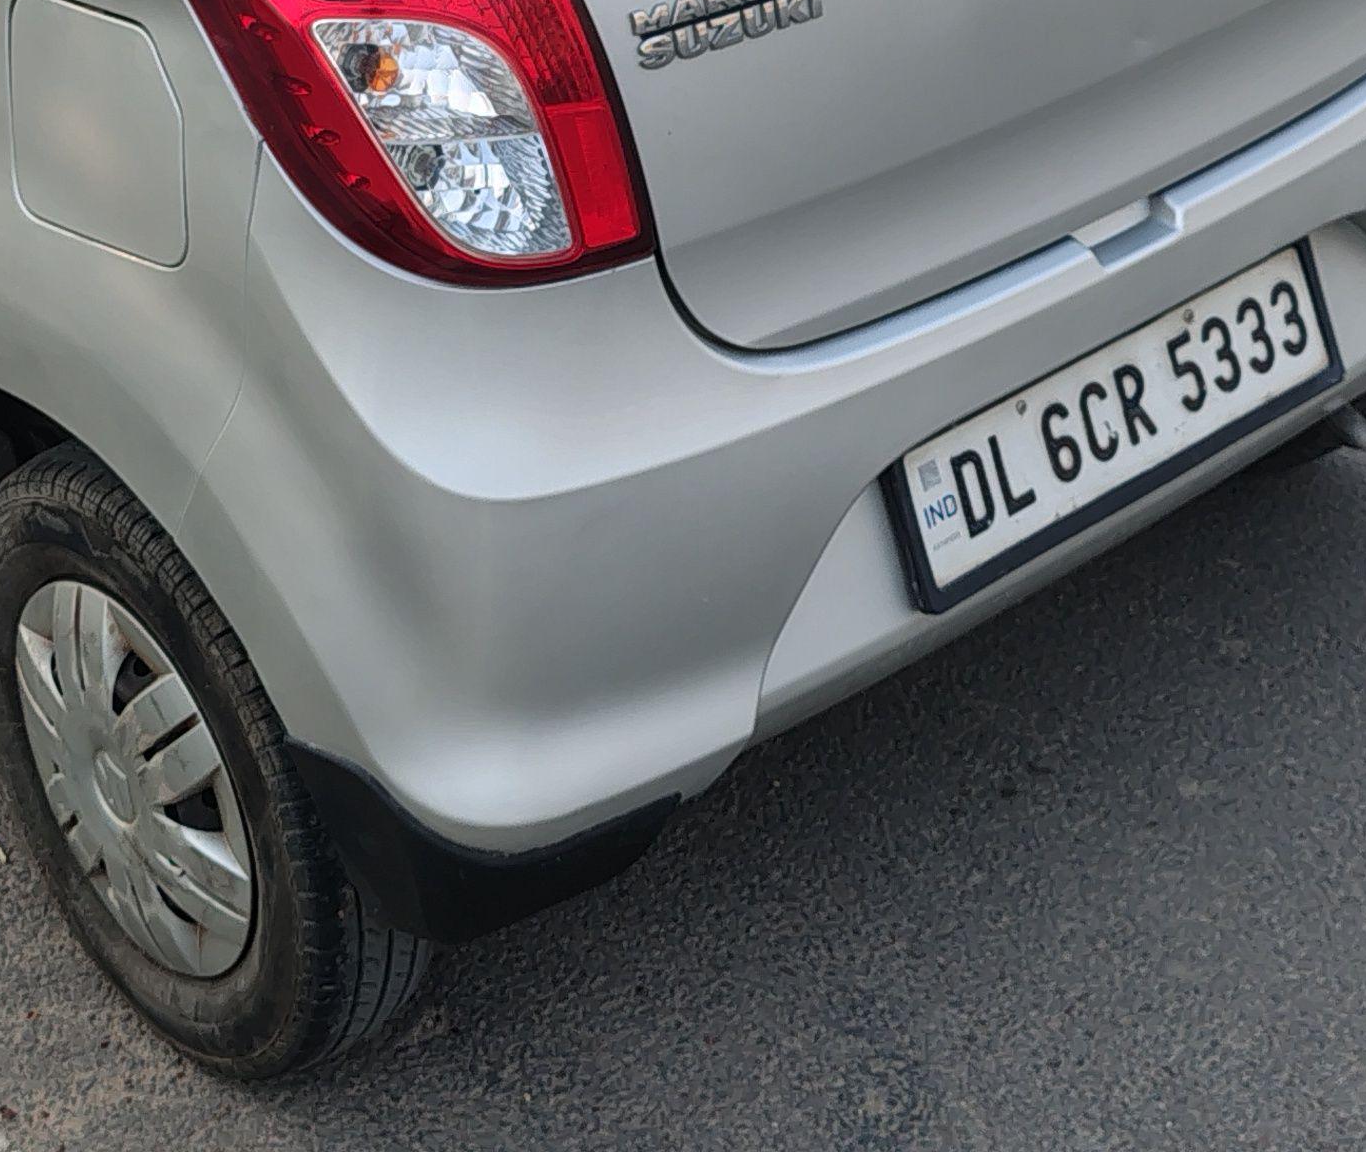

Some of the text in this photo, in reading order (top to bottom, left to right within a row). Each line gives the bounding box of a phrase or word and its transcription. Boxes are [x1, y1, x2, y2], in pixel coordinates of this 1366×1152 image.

[950, 280, 1308, 539] DL 6CR 5333
[923, 493, 959, 530] IND
